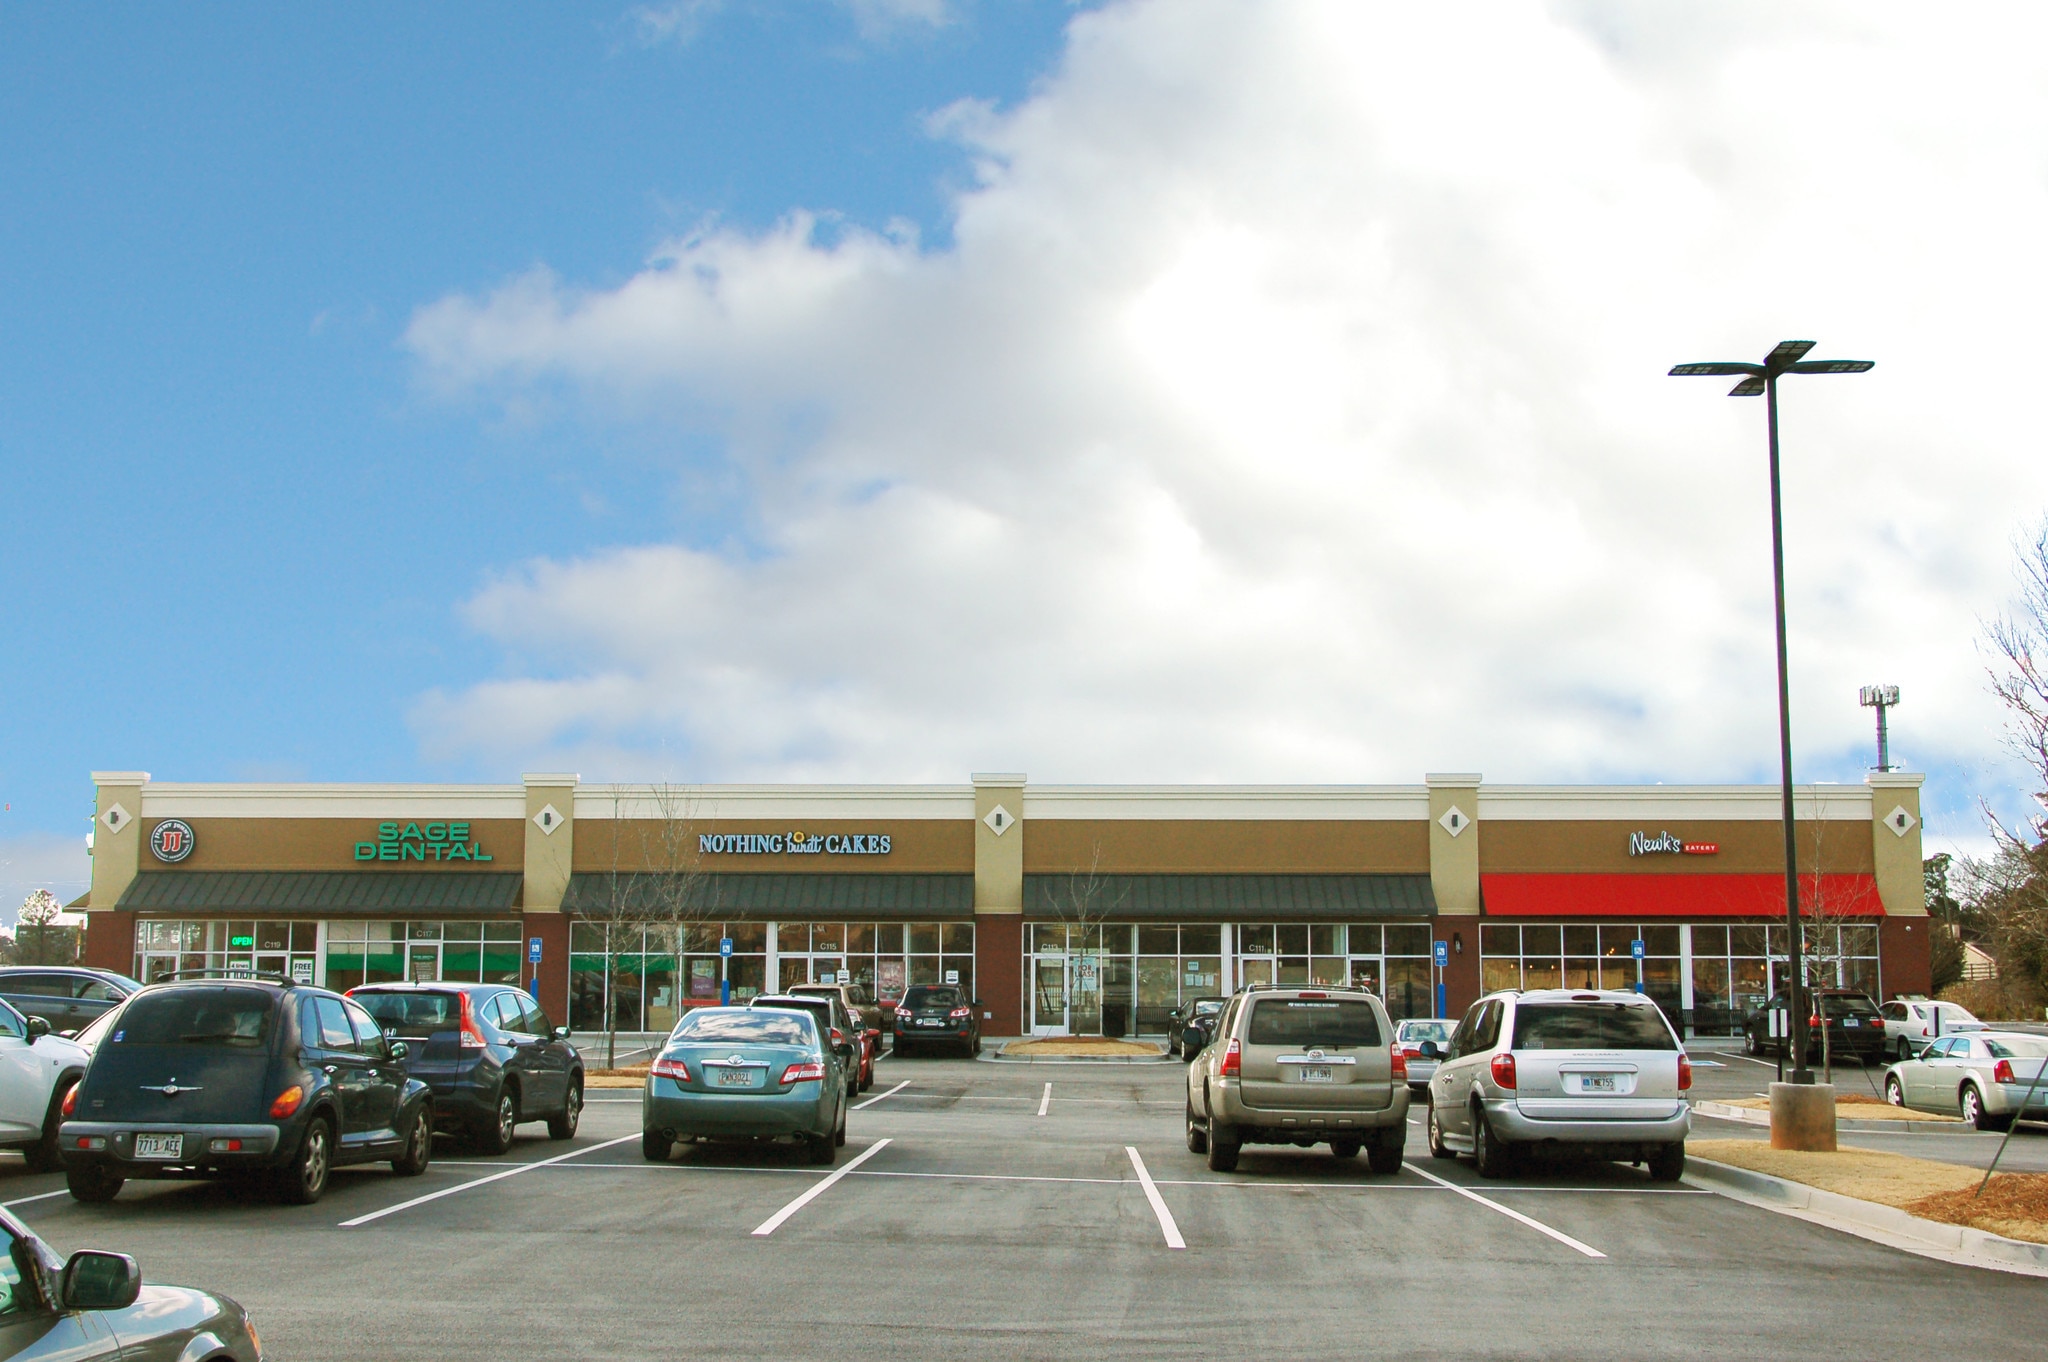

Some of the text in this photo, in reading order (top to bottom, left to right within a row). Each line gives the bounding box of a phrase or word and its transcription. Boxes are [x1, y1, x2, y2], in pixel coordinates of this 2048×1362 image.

[378, 822, 470, 841] SAGE
[162, 831, 182, 852] JJ
[699, 831, 891, 854] NOTHING bundt CAKES
[1629, 830, 1681, 856] Newk's
[354, 842, 493, 861] DENTAL
[416, 930, 433, 938] C117
[231, 936, 253, 946] OPEN
[264, 941, 281, 949] C119
[819, 942, 837, 950] C115
[1249, 944, 1264, 952] C111
[1811, 945, 1831, 953] C07
[138, 1139, 158, 1151] 7713
